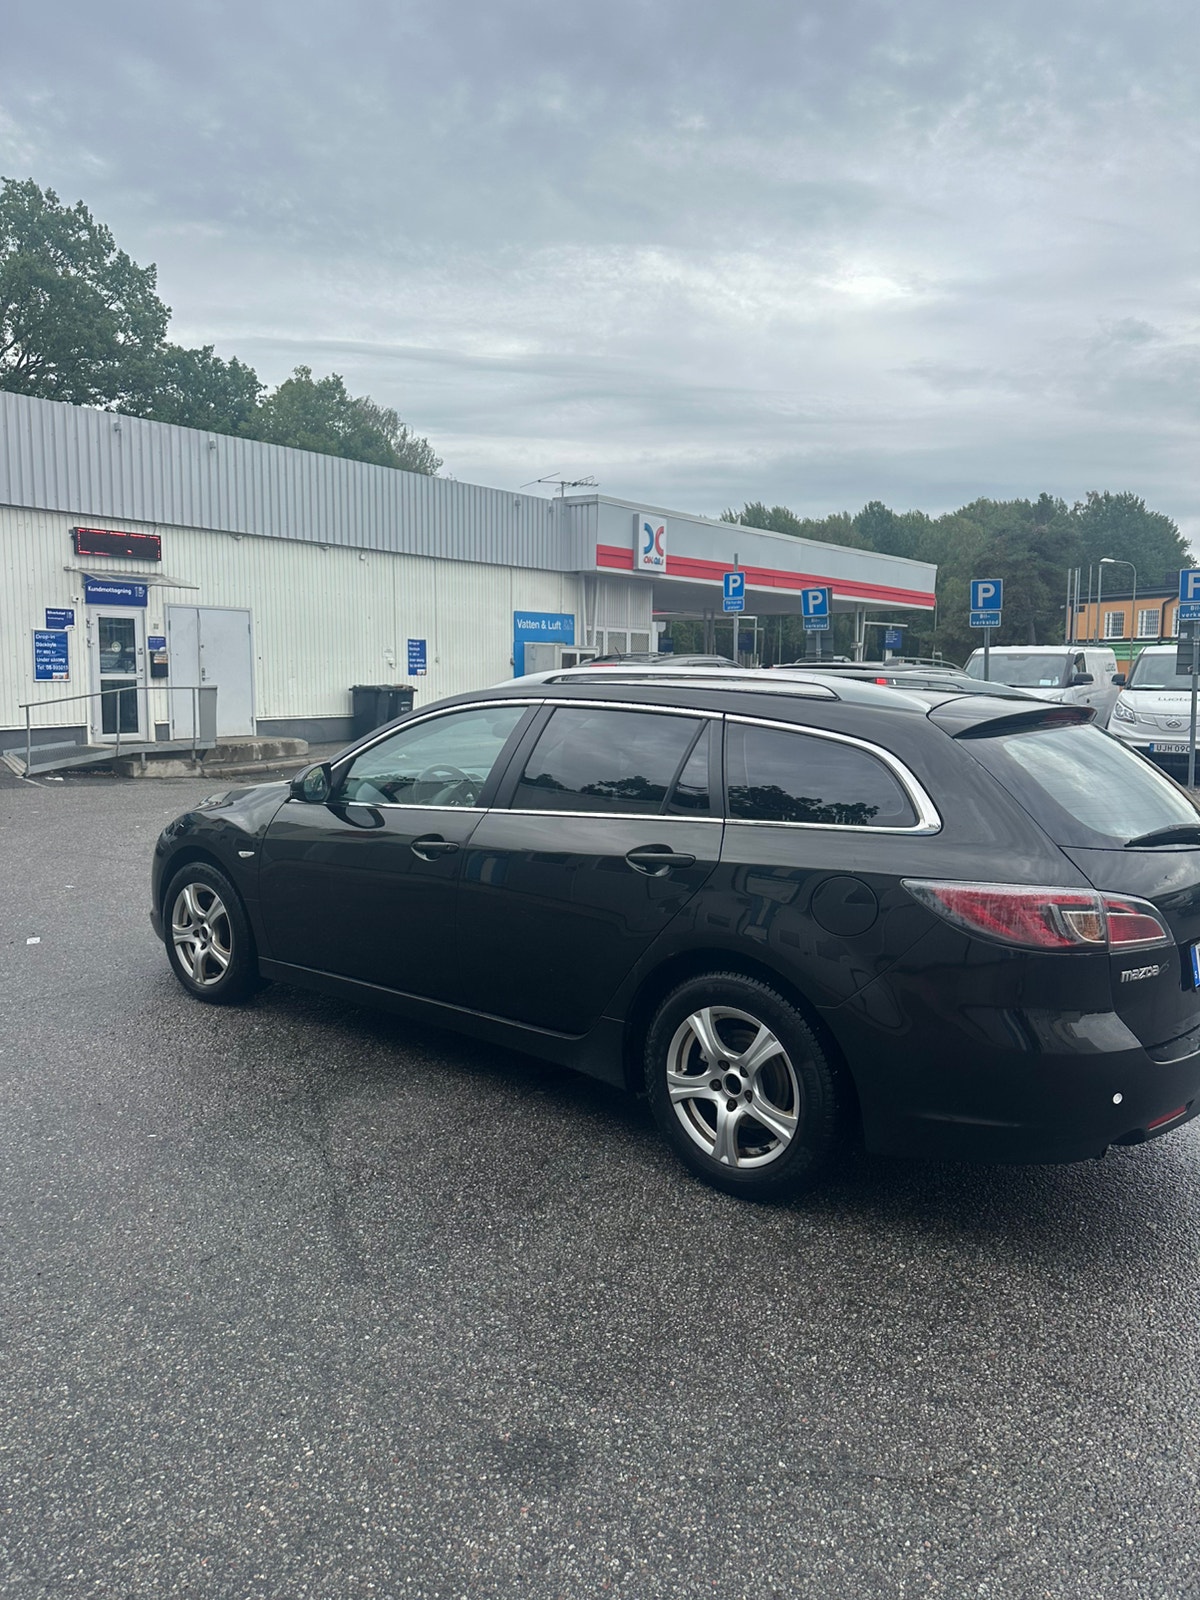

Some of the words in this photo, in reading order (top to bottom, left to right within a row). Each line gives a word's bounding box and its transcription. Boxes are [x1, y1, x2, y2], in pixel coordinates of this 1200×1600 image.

[88, 586, 132, 595] Kundmottagning
[729, 575, 741, 596] P
[978, 583, 995, 607] P
[808, 591, 823, 614] P
[517, 619, 540, 629] Vatten
[541, 620, 547, 630] &
[547, 620, 562, 630] Luft
[1121, 964, 1160, 983] mazda
